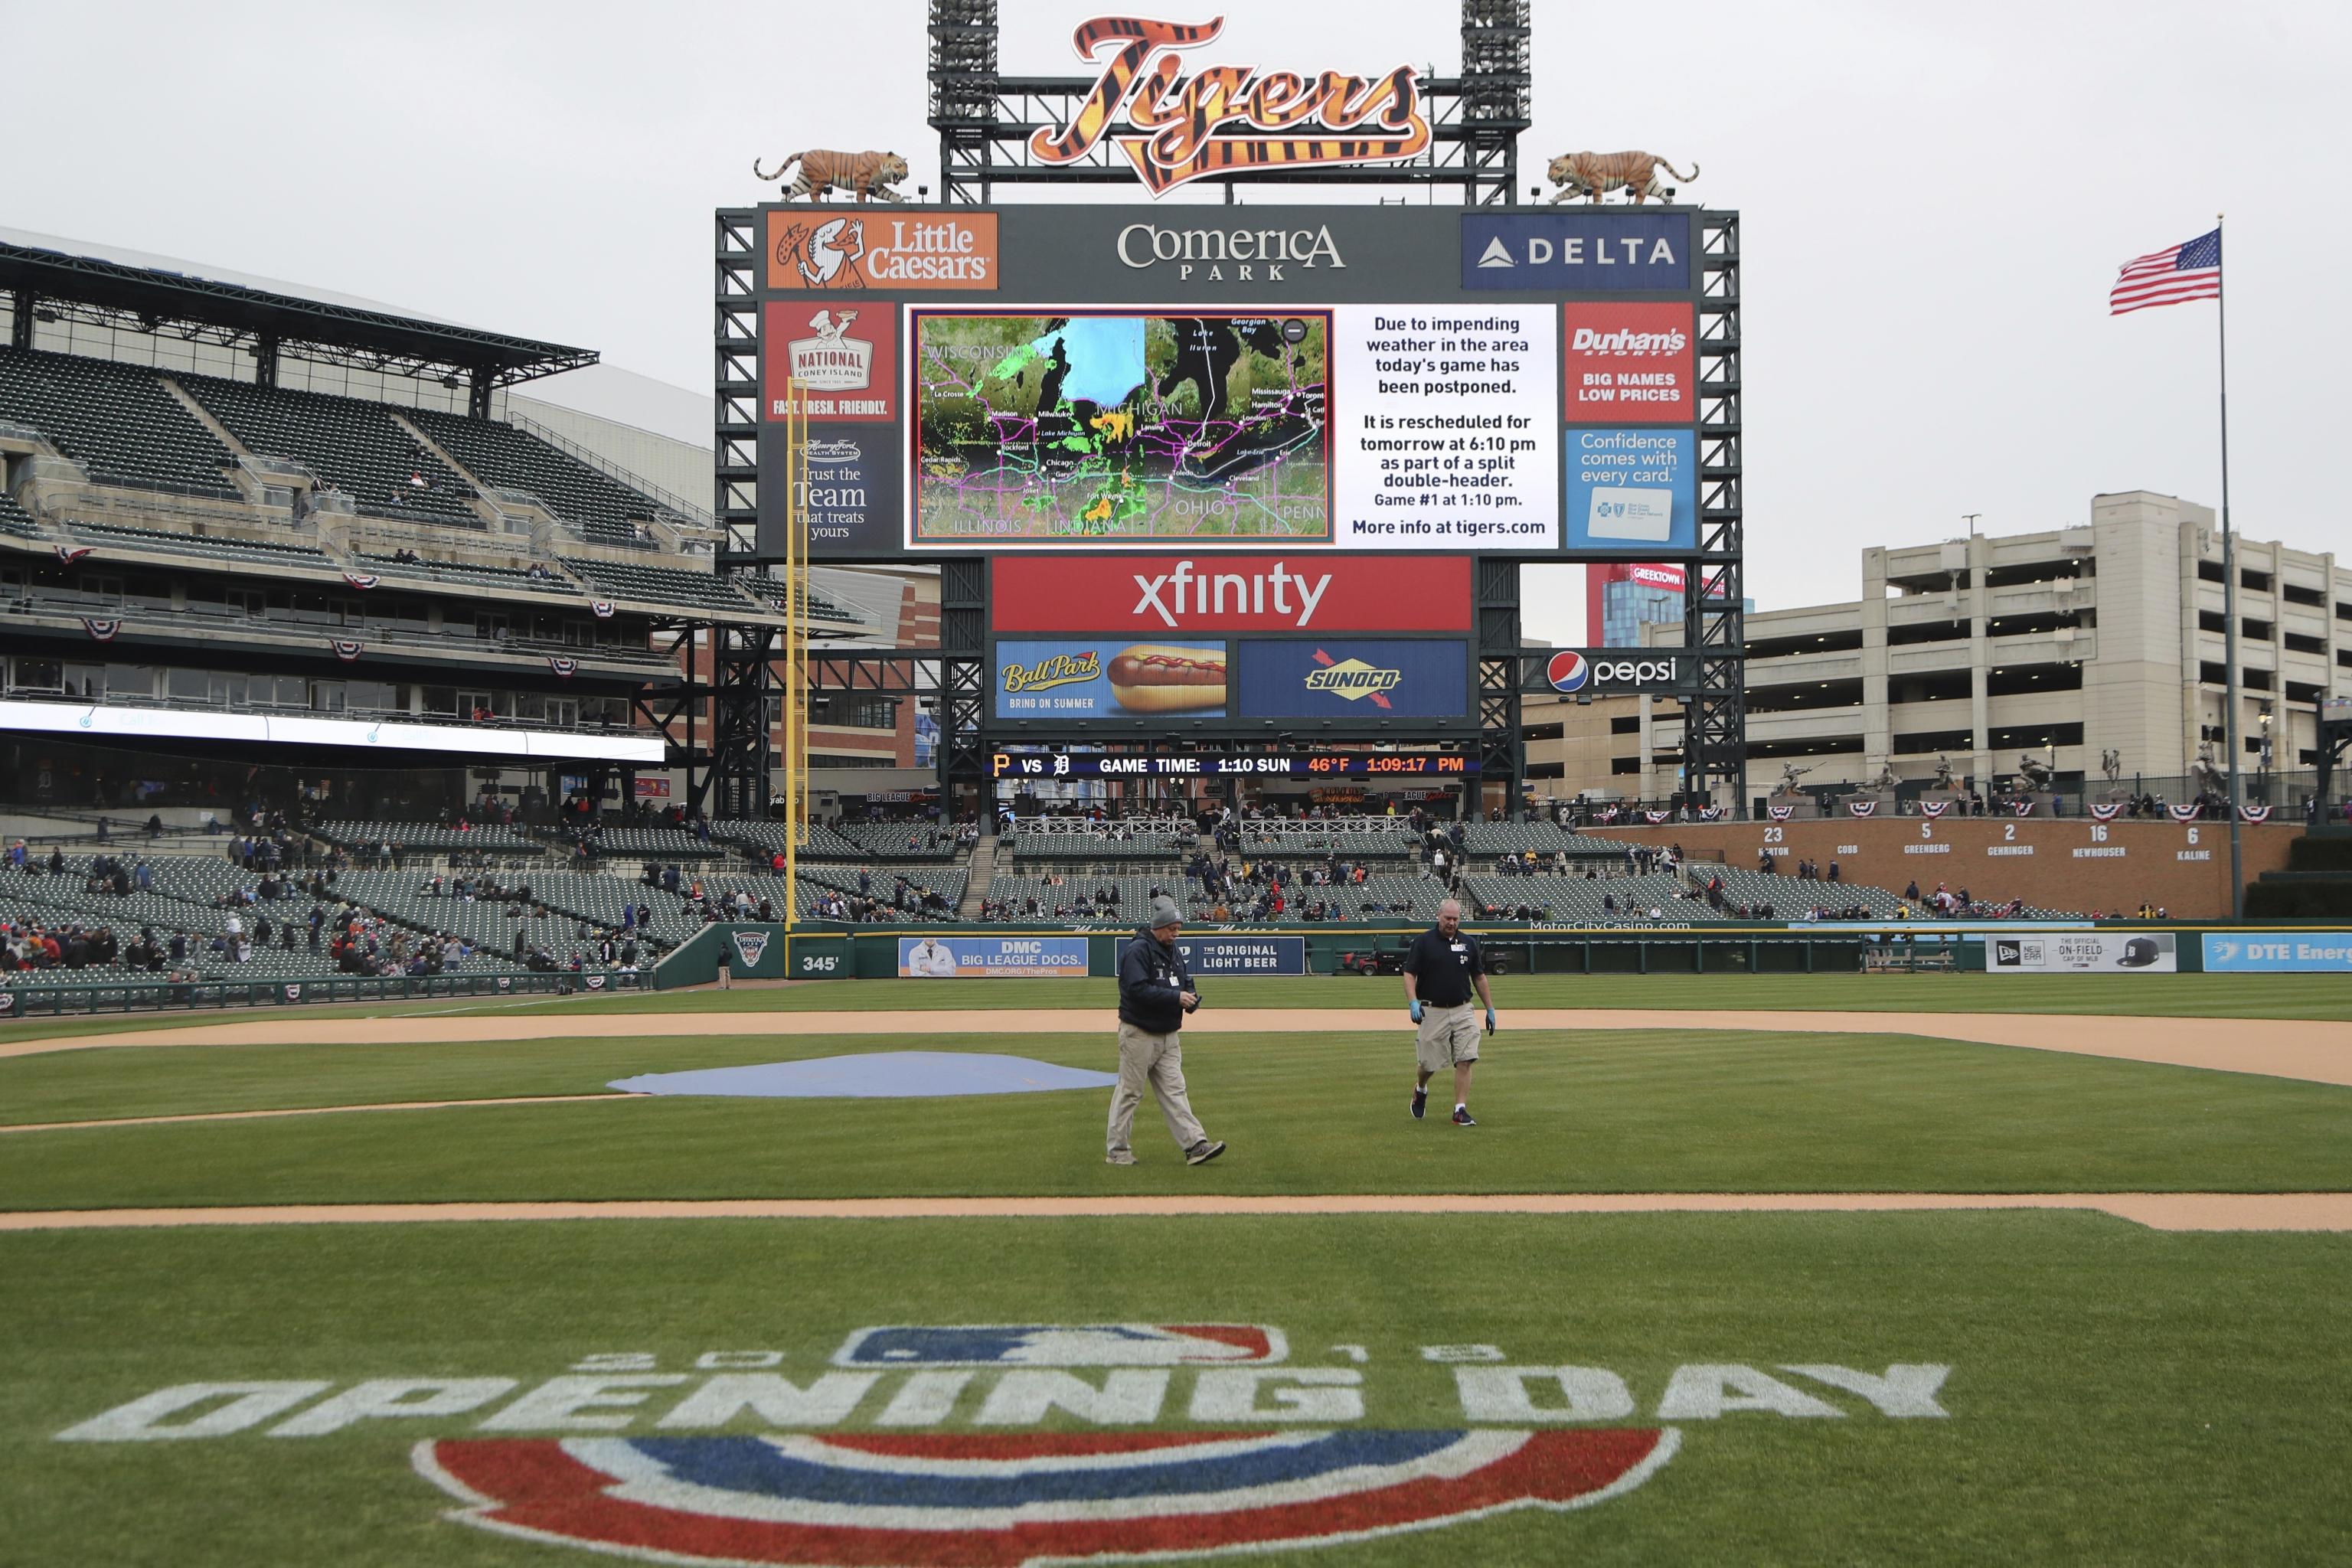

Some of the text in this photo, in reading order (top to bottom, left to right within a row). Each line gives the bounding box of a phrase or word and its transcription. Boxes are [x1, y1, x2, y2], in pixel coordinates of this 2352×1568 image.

[1028, 13, 1431, 188] Tigers
[892, 220, 973, 253] Little
[1527, 237, 1676, 265] DELTA
[867, 247, 987, 281] Caesars
[1180, 265, 1285, 282] PARK
[1231, 318, 1266, 326] Georgian
[1374, 317, 1520, 334] Due to impending
[1242, 326, 1256, 335] Bay
[1367, 338, 1529, 352] weather in the area
[1572, 328, 1687, 351] Dunham's
[798, 351, 864, 368] NATIONAL
[926, 345, 1023, 359] WISCONSIN
[798, 368, 862, 377] CONEY ISLAND
[1376, 358, 1520, 374] today's game has
[1583, 373, 1676, 386] BIG NAMES
[1252, 388, 1291, 397] Mississauga
[1378, 380, 1517, 397] been postponed.
[1579, 389, 1681, 402] LOW PRICES
[839, 400, 887, 415] FRIENDLY.
[1096, 403, 1183, 416] MICHIGAN
[1364, 415, 1531, 429] It is rescheduled for
[837, 439, 857, 449] Ford
[1361, 437, 1536, 453] tomorrow at 6:10 pm
[1581, 433, 1677, 449] Confidence
[1047, 459, 1073, 468] Chicago
[1380, 456, 1515, 472] as part of a split
[1581, 449, 1677, 466] comes with
[799, 467, 861, 481] Trust the
[1383, 473, 1513, 488] double-header.
[1581, 466, 1673, 486] every card.
[793, 482, 867, 508] Team
[1100, 492, 1122, 501] Wayne
[1374, 494, 1522, 508] Game #1 at 1:10 pm.
[1175, 500, 1225, 515] OHIO
[797, 511, 865, 524] that treats
[954, 520, 1022, 532] ILLINOIS
[1054, 520, 1126, 532] INDIANA
[1353, 520, 1545, 537] More info at tigers.com
[810, 527, 850, 541] yours
[1633, 567, 1681, 586] GREEKTOWN
[1132, 560, 1332, 627] xfinity
[1001, 652, 1101, 693] Ball Park
[1310, 671, 1397, 688] SUNOCO
[1594, 657, 1677, 687] pepsi
[1009, 698, 1093, 709] BRING ON SUMMER
[993, 754, 1010, 777] P
[1021, 759, 1043, 773] VS
[1099, 759, 1148, 773] GAME
[1155, 759, 1200, 773] TIME:
[1217, 759, 1253, 773] 1:10
[1256, 758, 1290, 772] SUN
[1367, 758, 1426, 772] 1:09:17
[1438, 758, 1464, 772] PM
[867, 792, 910, 802] BIG LEAGUE
[1764, 827, 1783, 842] 23
[1922, 823, 1932, 839] 5
[2004, 824, 2015, 841] 2
[2089, 825, 2107, 842] 16
[2187, 827, 2199, 844] 6
[1838, 845, 1858, 854] COBB
[1904, 844, 1950, 854] GREENBERG
[1988, 846, 2034, 856] GEHRINGER
[2073, 847, 2126, 858] NEWHOUSER
[2177, 850, 2210, 861] KALINE
[1001, 942, 1042, 954] DMC
[1217, 946, 1277, 956] ORIGINAL
[2059, 946, 2102, 955] ON-FIELD
[2247, 944, 2291, 960] DTE
[803, 957, 838, 971] 345'
[962, 955, 1081, 965] BIG LEAGUE DOCS.
[1204, 958, 1277, 968] LIGHT BEER
[51, 1363, 1949, 1442] OPENING DAY
